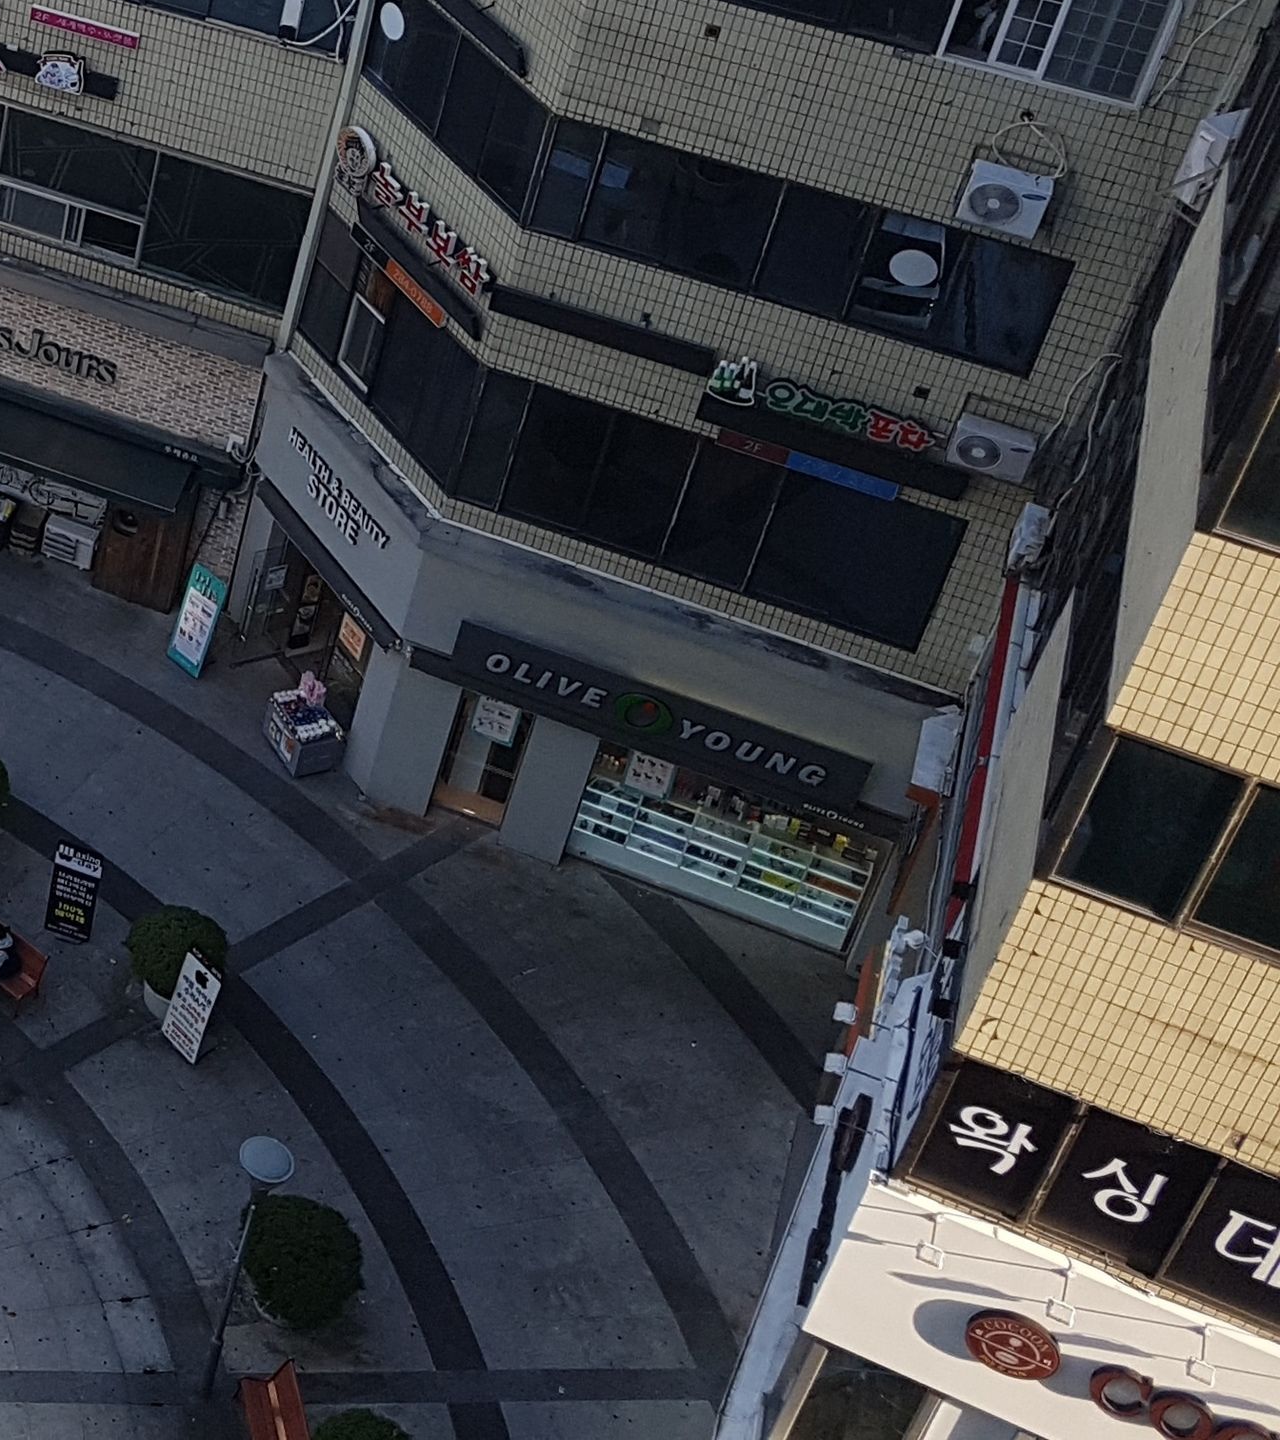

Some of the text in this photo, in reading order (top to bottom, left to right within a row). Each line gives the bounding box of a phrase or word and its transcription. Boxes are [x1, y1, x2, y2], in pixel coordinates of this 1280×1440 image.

[34, 10, 51, 22] 2F
[12, 327, 119, 387] Jours
[742, 440, 764, 456] 2F
[287, 426, 331, 483] HEALTH
[339, 486, 391, 550] BEAUTY
[305, 472, 359, 547] STORE
[484, 652, 829, 790] OLIVE YOUNG
[980, 1318, 1052, 1360] COCOON
